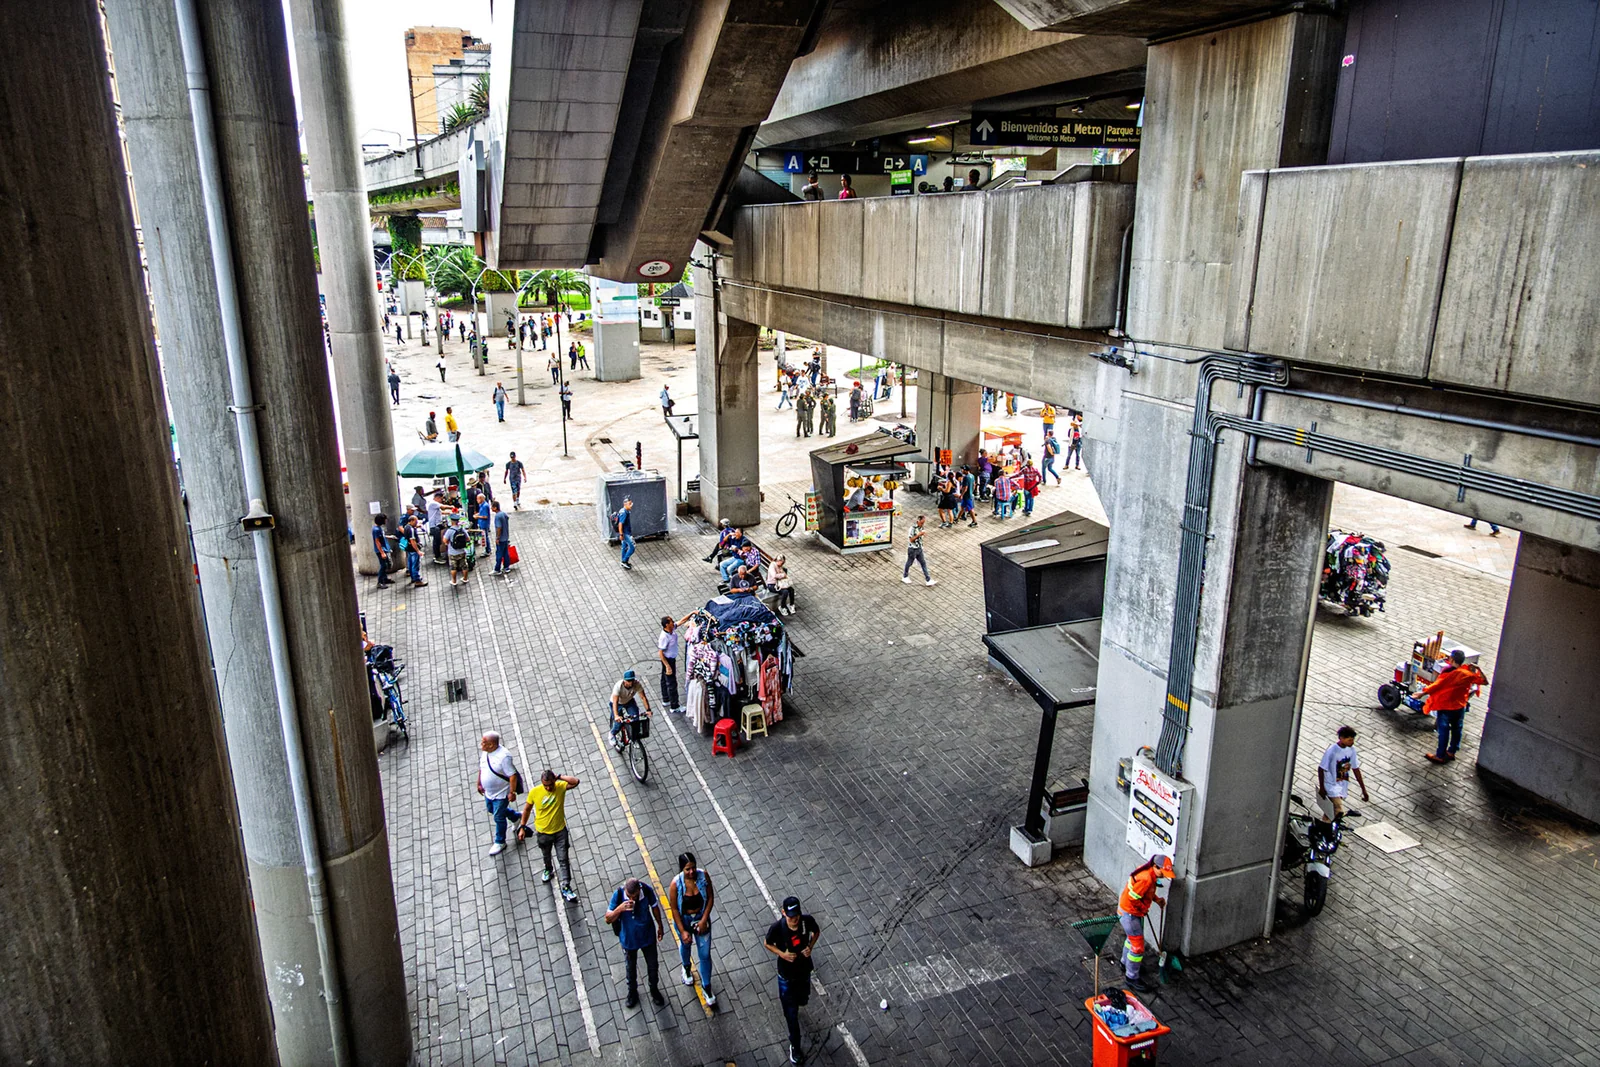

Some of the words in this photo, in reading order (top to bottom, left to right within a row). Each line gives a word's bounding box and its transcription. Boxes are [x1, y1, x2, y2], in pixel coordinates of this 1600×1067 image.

[1001, 121, 1058, 134] Bienvenidos
[1062, 123, 1071, 134] al
[1074, 124, 1102, 135] Metro
[1107, 125, 1134, 137] Parque
[1027, 134, 1051, 142] Welcome
[1059, 135, 1076, 143] Metro
[788, 155, 799, 169] A
[913, 158, 923, 172] A
